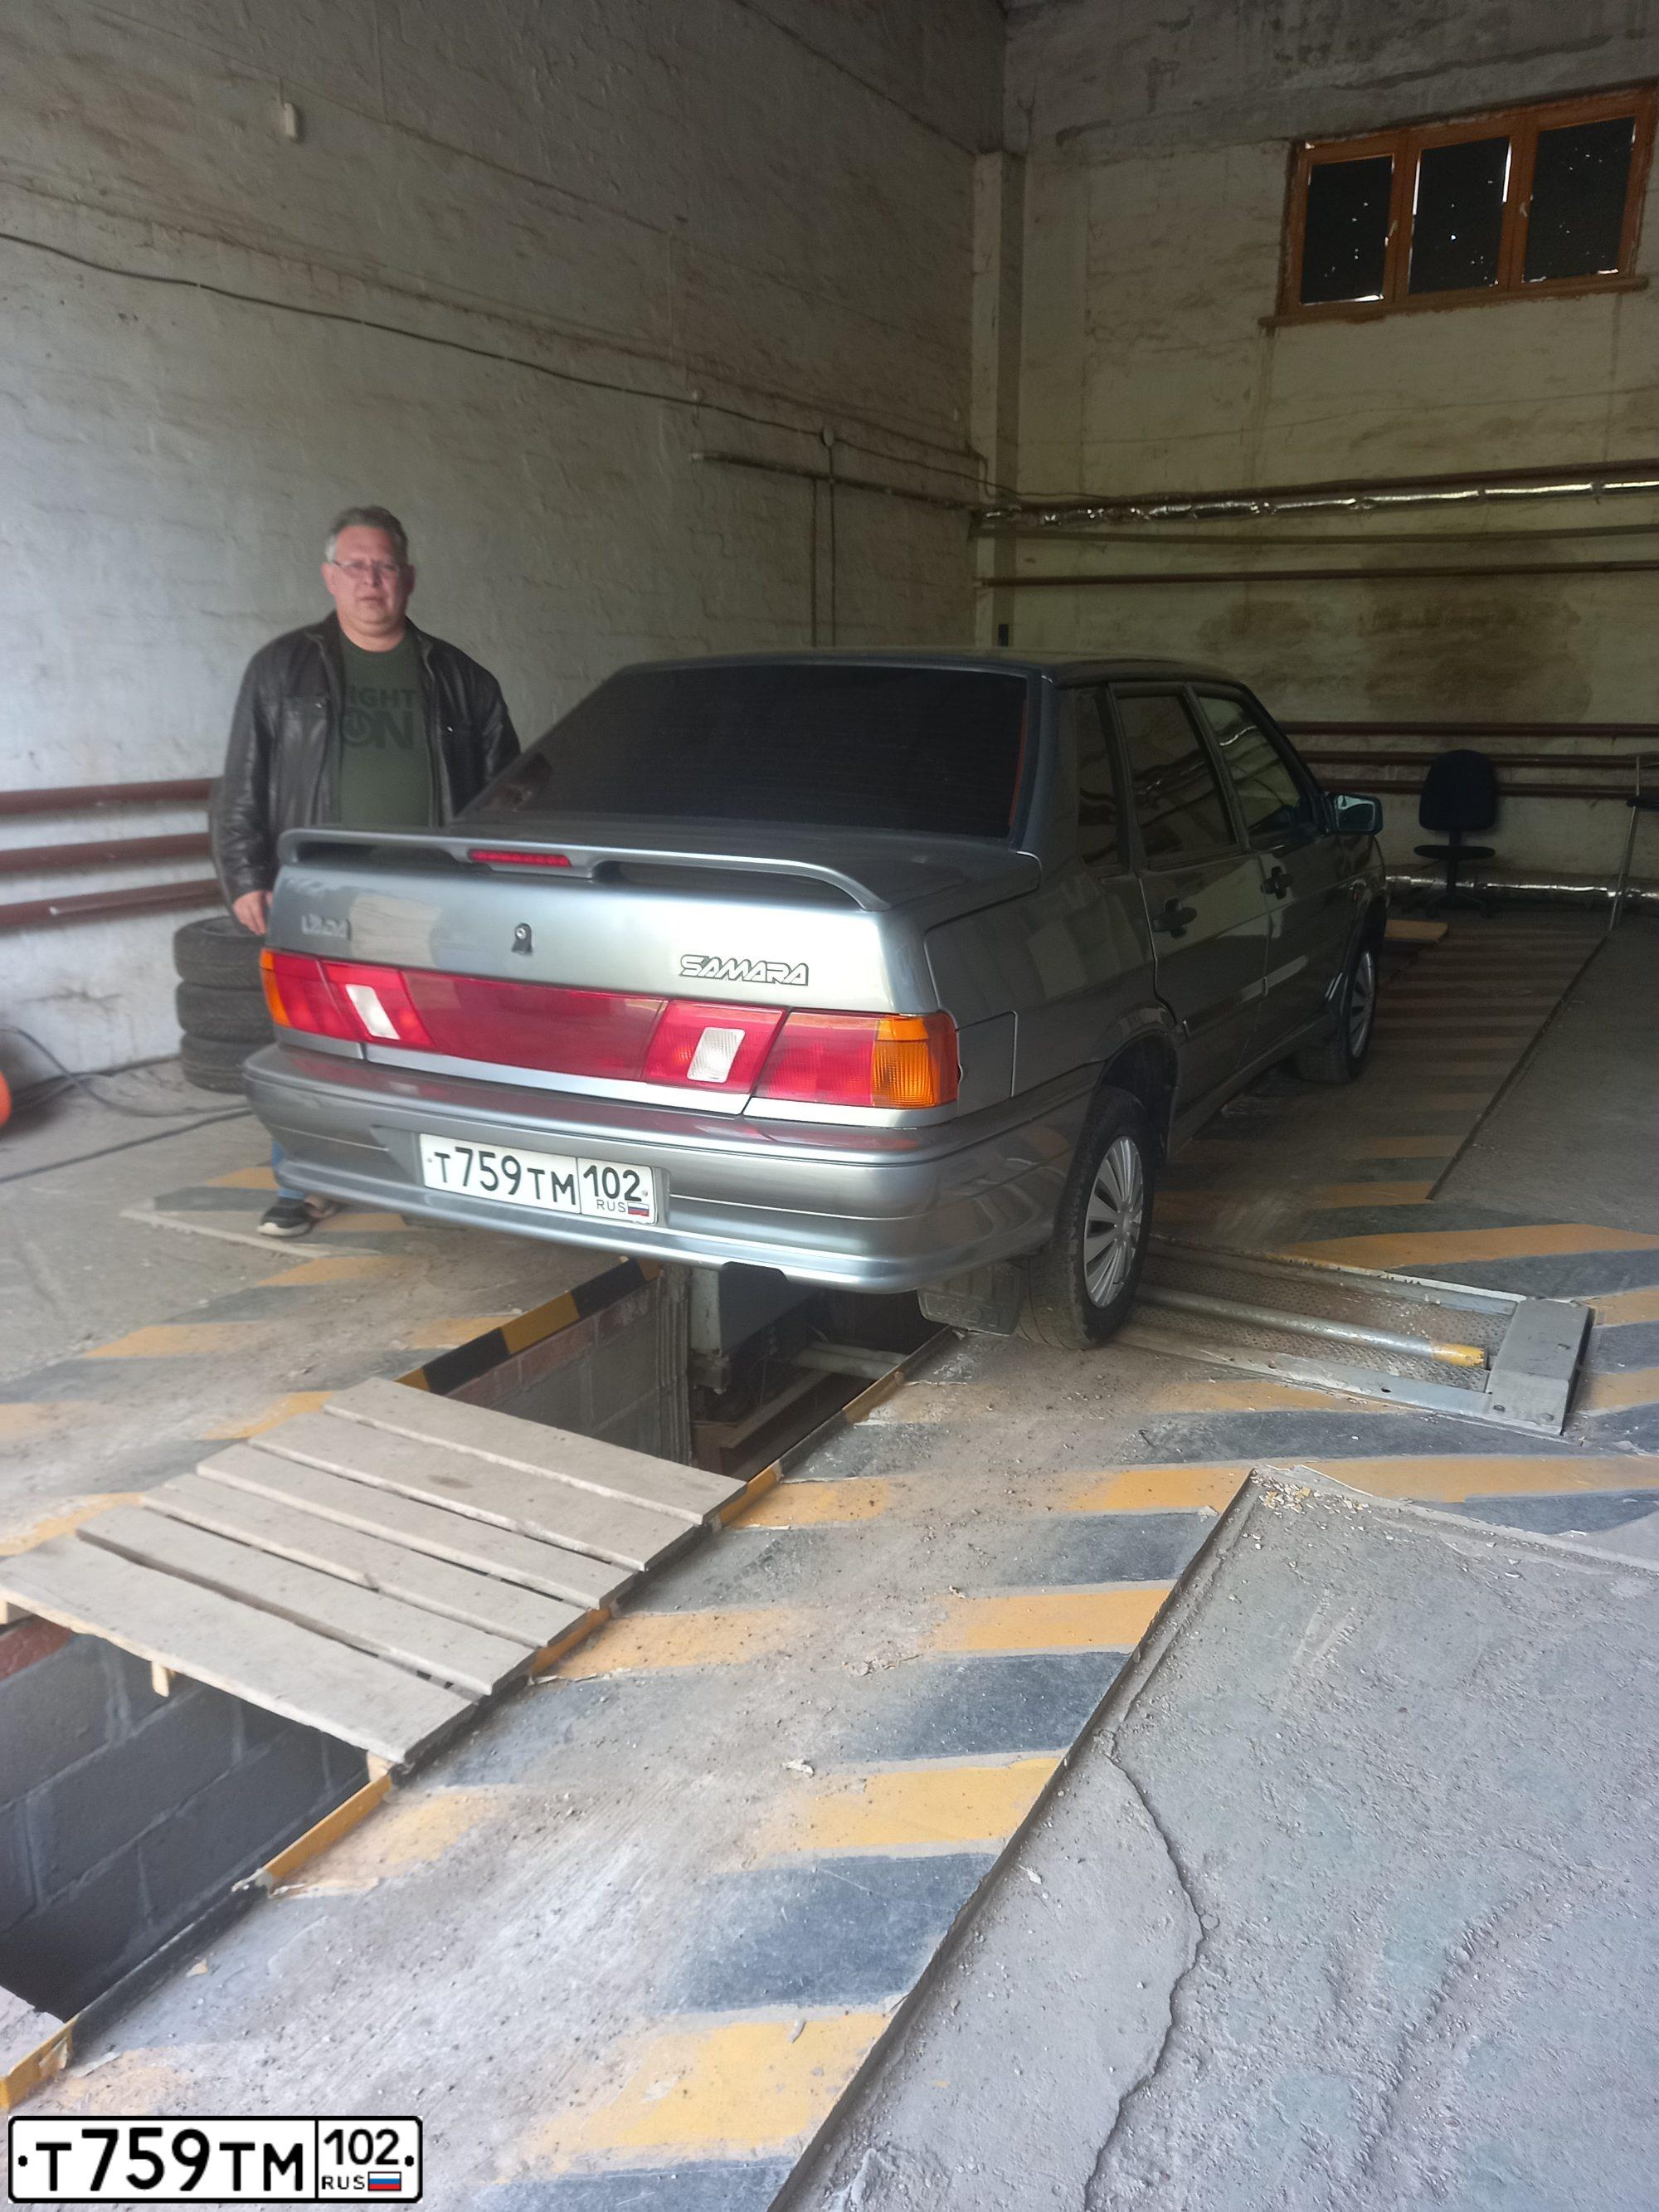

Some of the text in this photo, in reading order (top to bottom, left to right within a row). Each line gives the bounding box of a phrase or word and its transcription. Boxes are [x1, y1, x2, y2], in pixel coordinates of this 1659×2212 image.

[679, 954, 809, 986] SAMARA
[583, 1164, 642, 1202] 102
[596, 1199, 625, 1213] RUS
